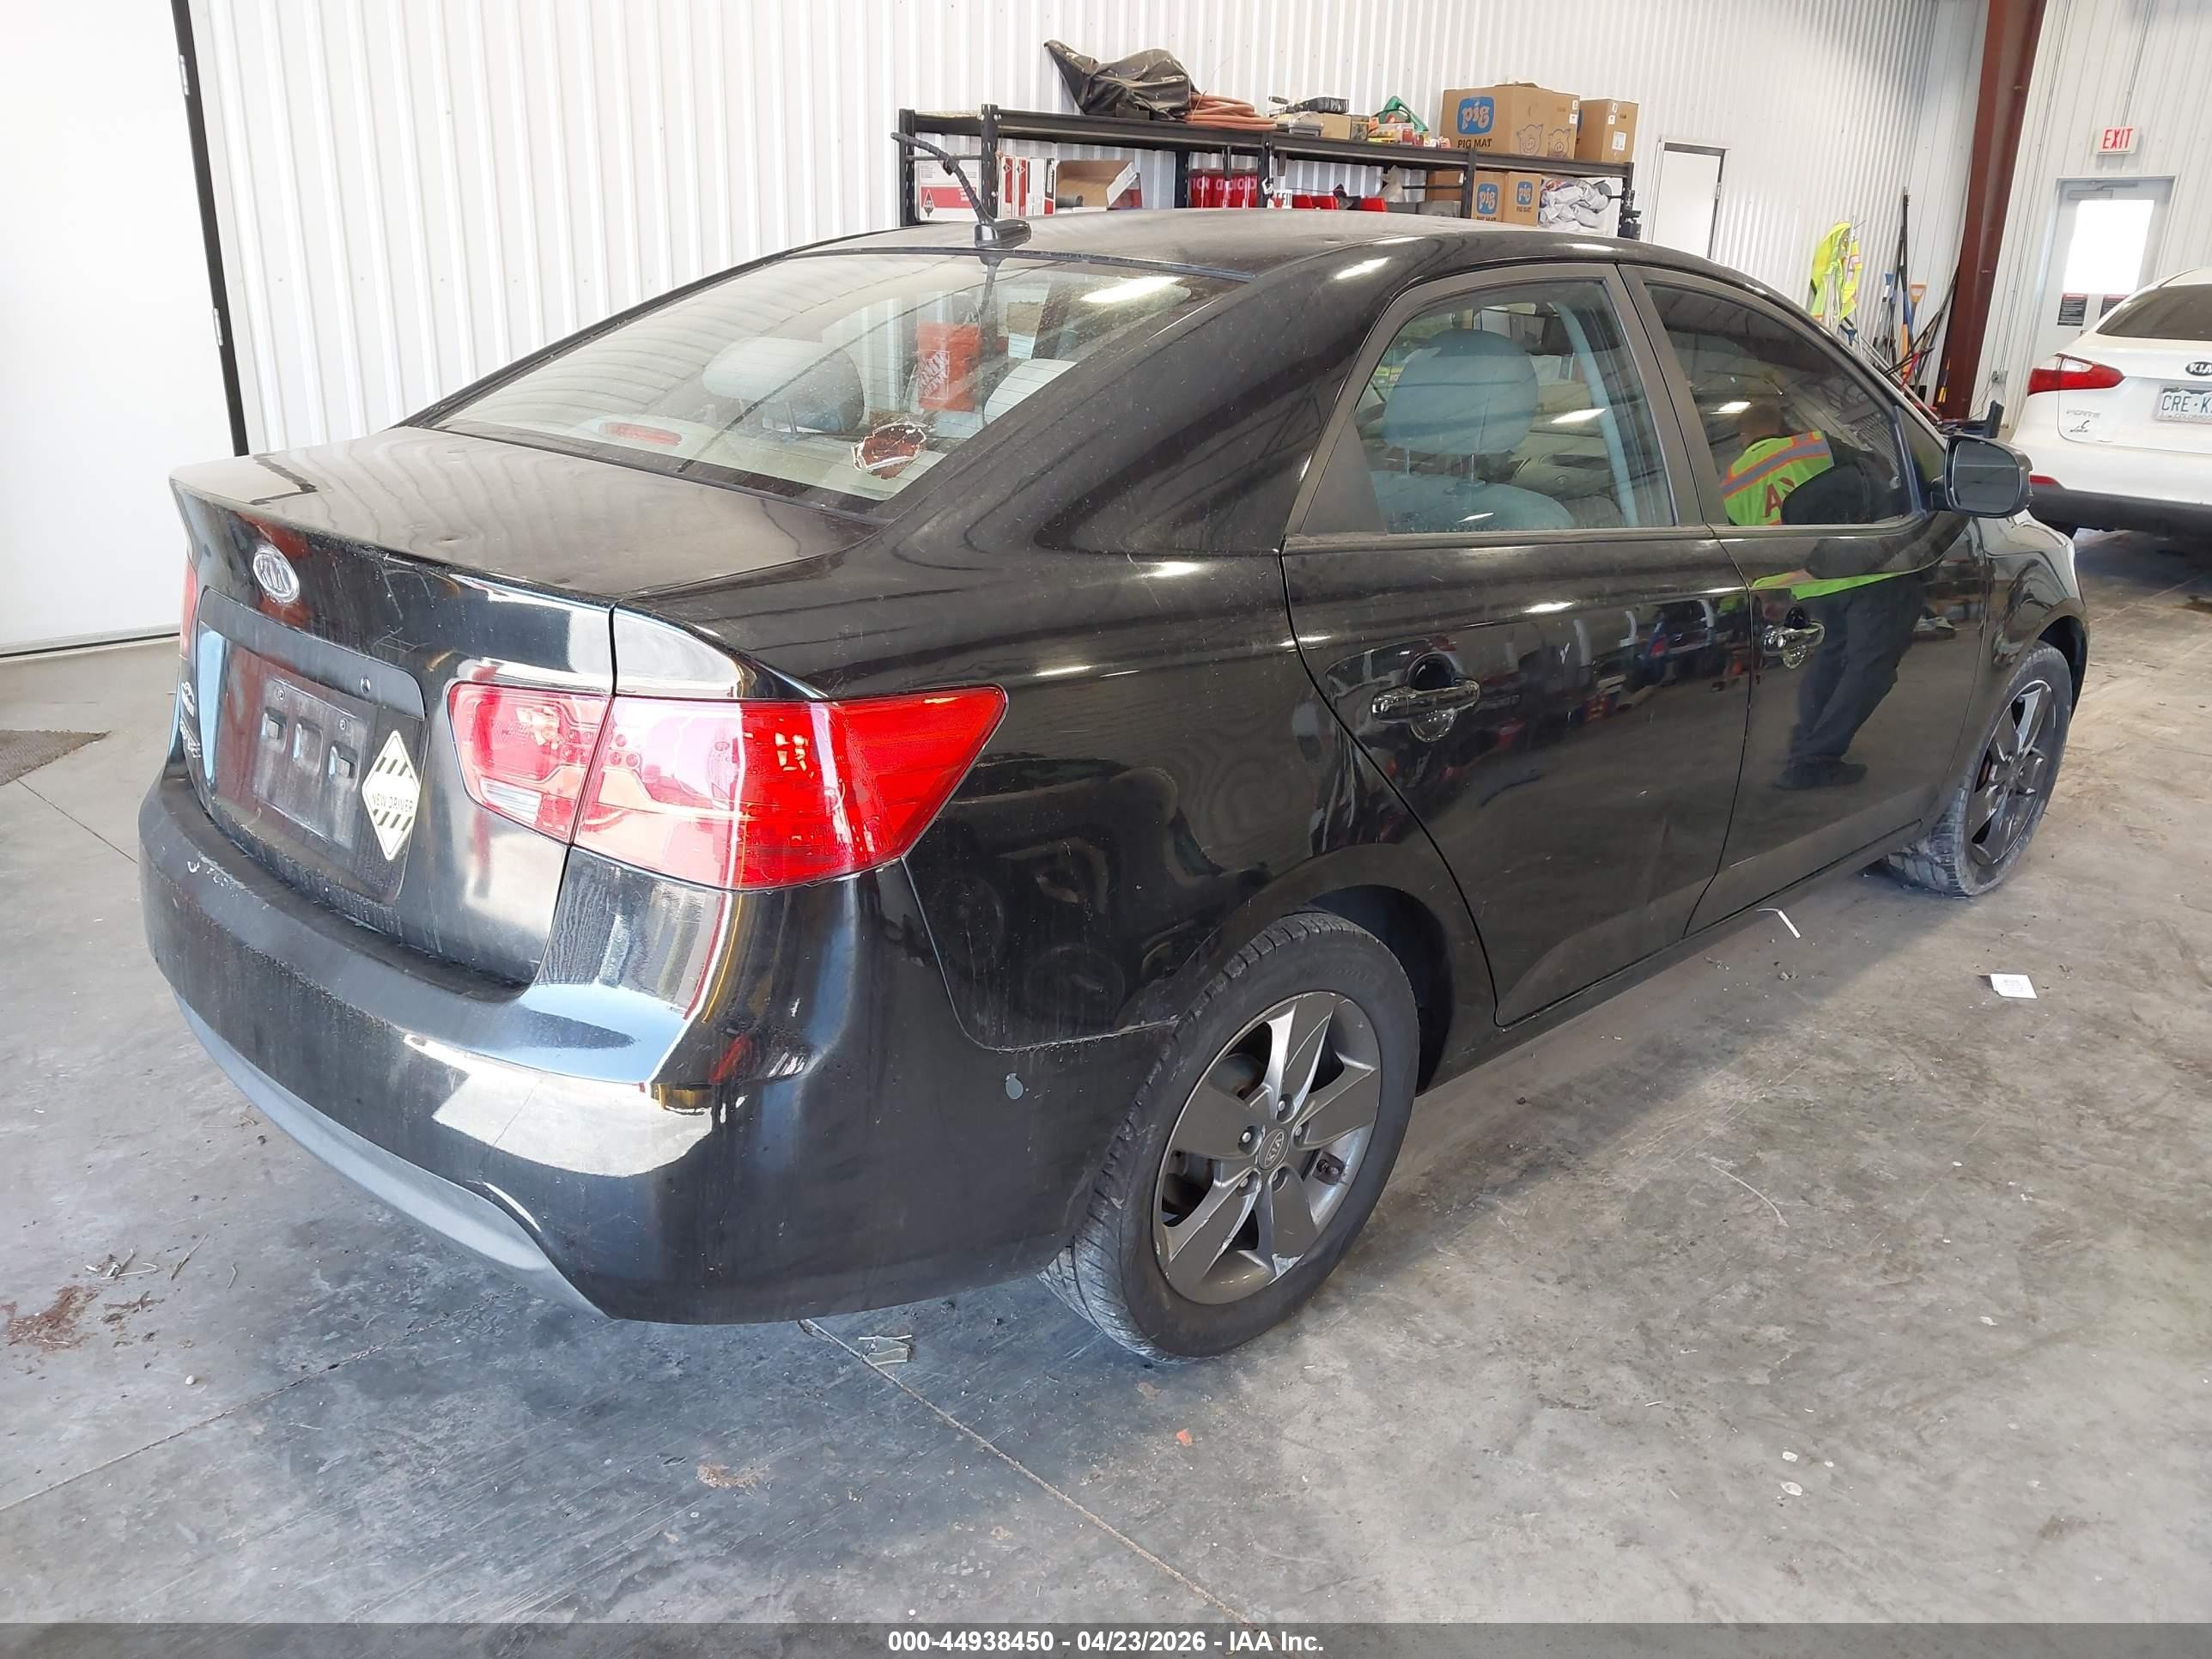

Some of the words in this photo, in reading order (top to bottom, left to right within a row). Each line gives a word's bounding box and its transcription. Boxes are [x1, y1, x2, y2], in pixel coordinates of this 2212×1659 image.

[1462, 100, 1491, 131] pig
[1457, 138, 1472, 149] PIG
[1474, 137, 1492, 148] MAT
[2102, 128, 2133, 149] EXIT
[2190, 363, 2212, 374] KIA
[372, 793, 387, 808] NEW
[388, 796, 413, 812] DRIVER
